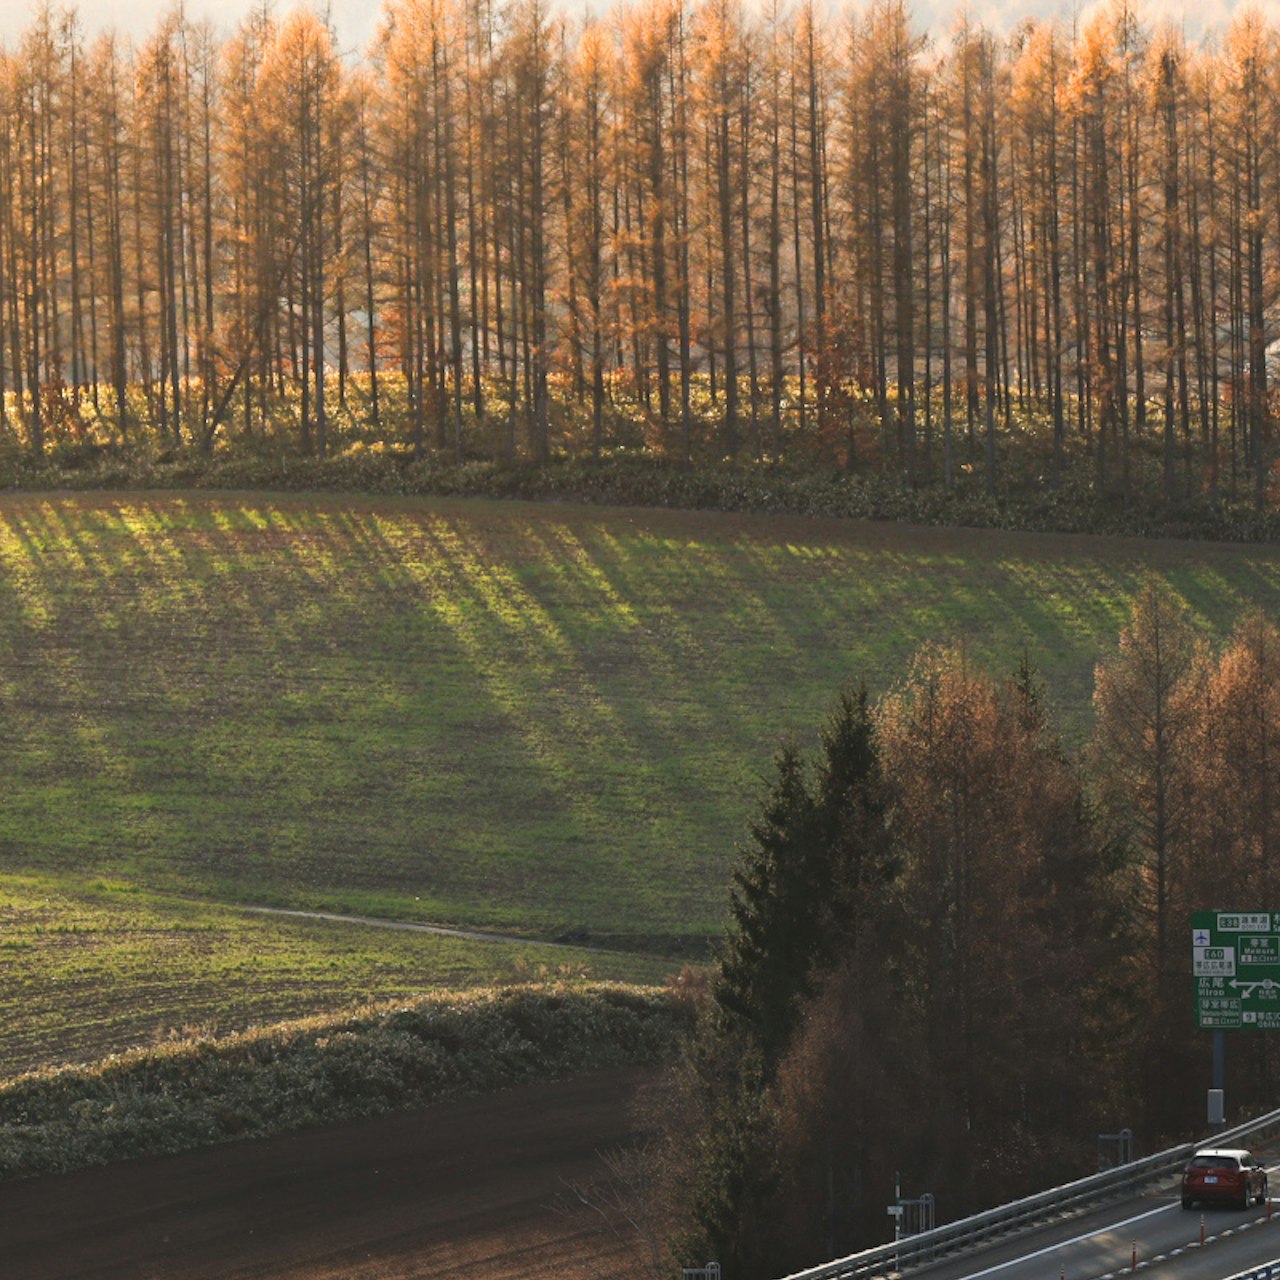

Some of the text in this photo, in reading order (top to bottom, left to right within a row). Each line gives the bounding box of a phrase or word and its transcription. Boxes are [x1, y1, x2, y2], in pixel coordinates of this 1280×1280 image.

[1220, 918, 1238, 927] E38
[1206, 950, 1223, 958] E60
[1198, 977, 1225, 988] 広尾
[1198, 988, 1225, 996] Hiroo
